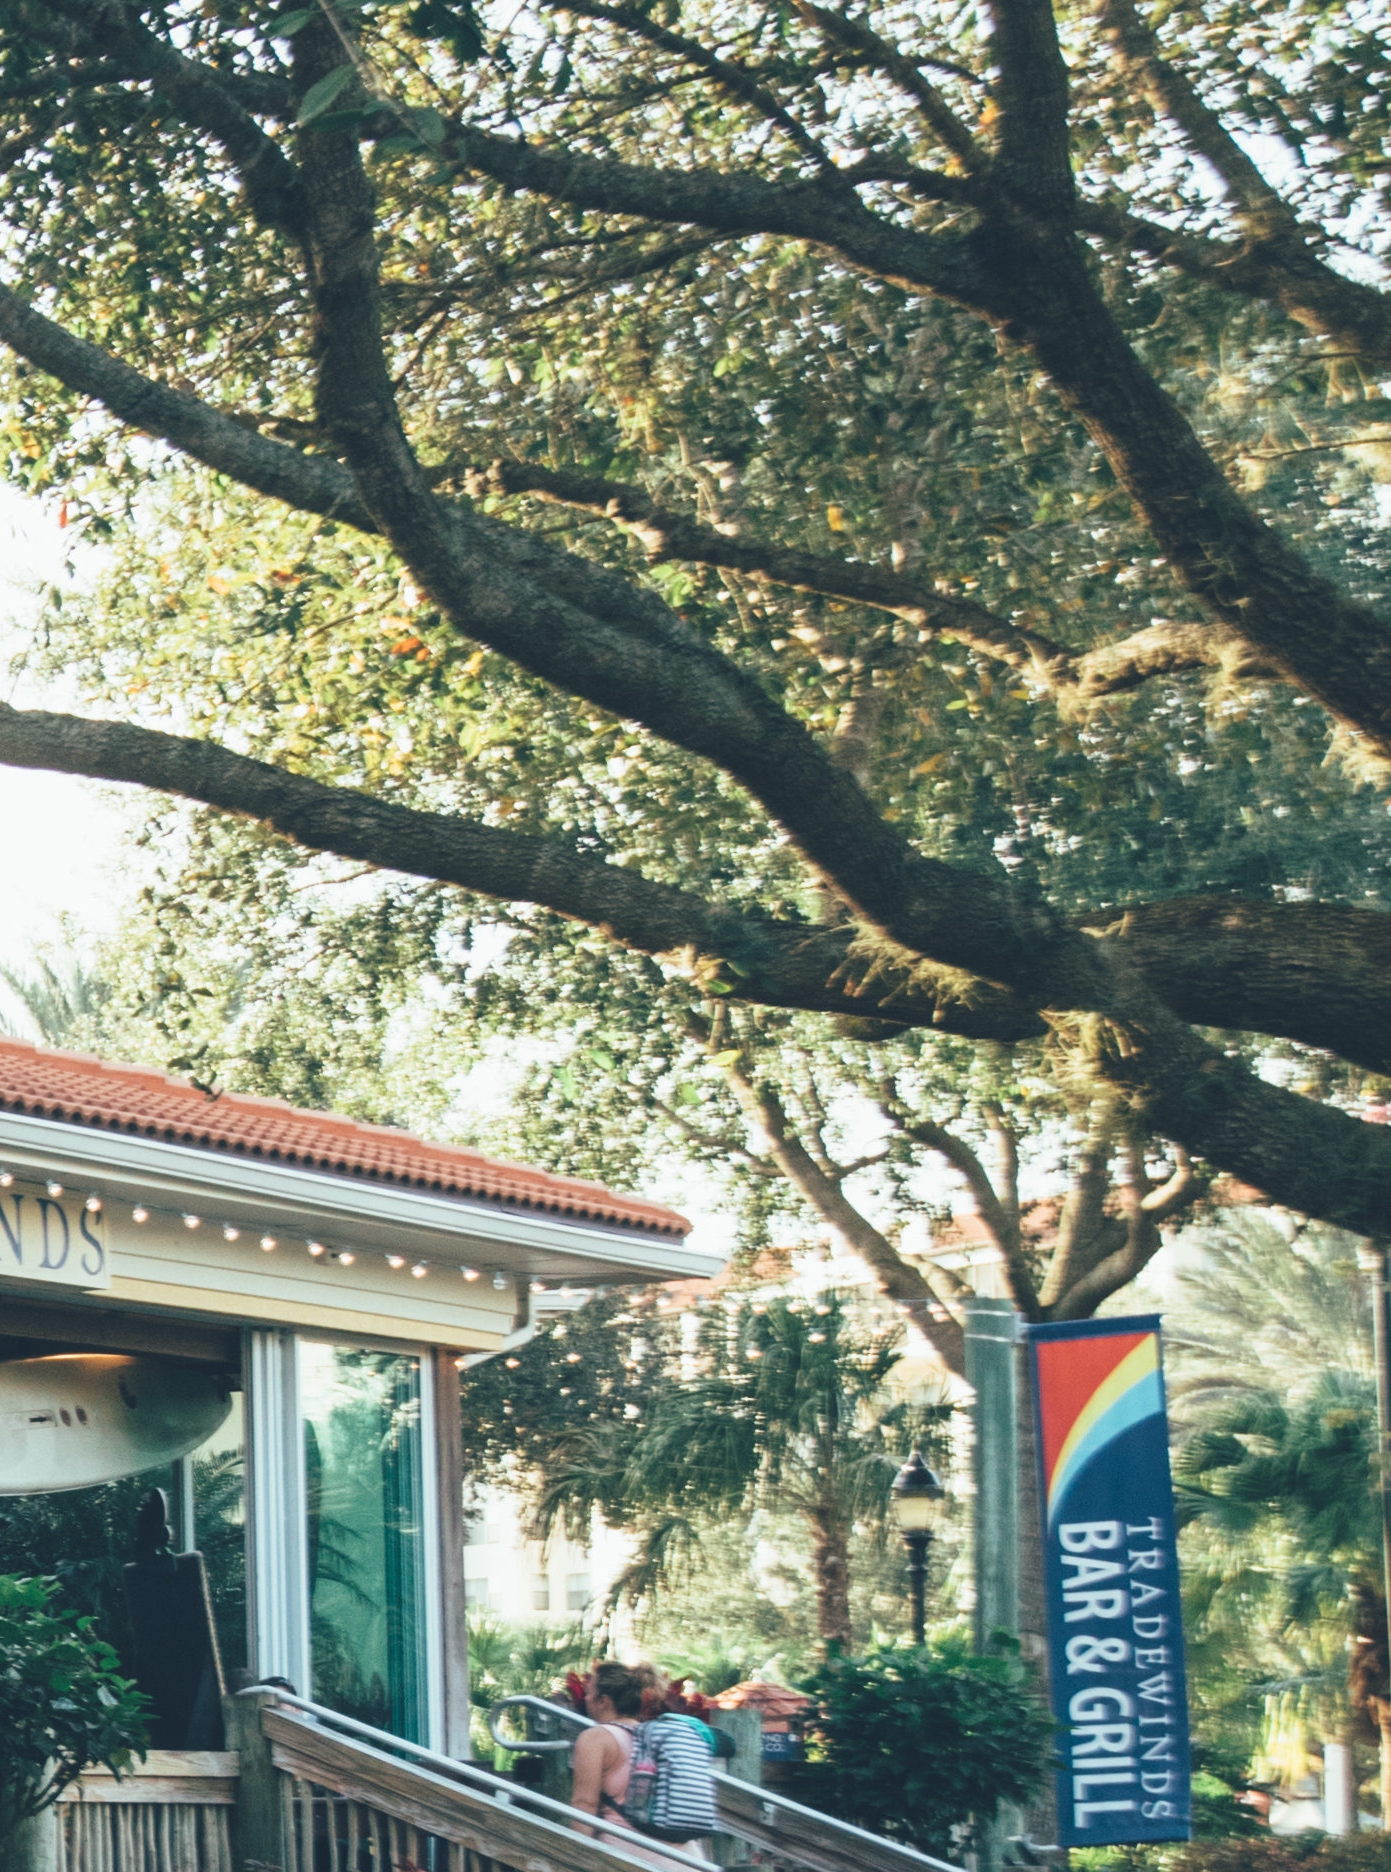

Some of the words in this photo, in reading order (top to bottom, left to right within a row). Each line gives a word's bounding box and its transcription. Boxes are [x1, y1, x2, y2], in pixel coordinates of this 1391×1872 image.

[1058, 1519, 1127, 1624] BAR
[1064, 1634, 1130, 1676] &
[1125, 1515, 1175, 1820] TRADEWINDS
[1069, 1685, 1139, 1830] GRILL
